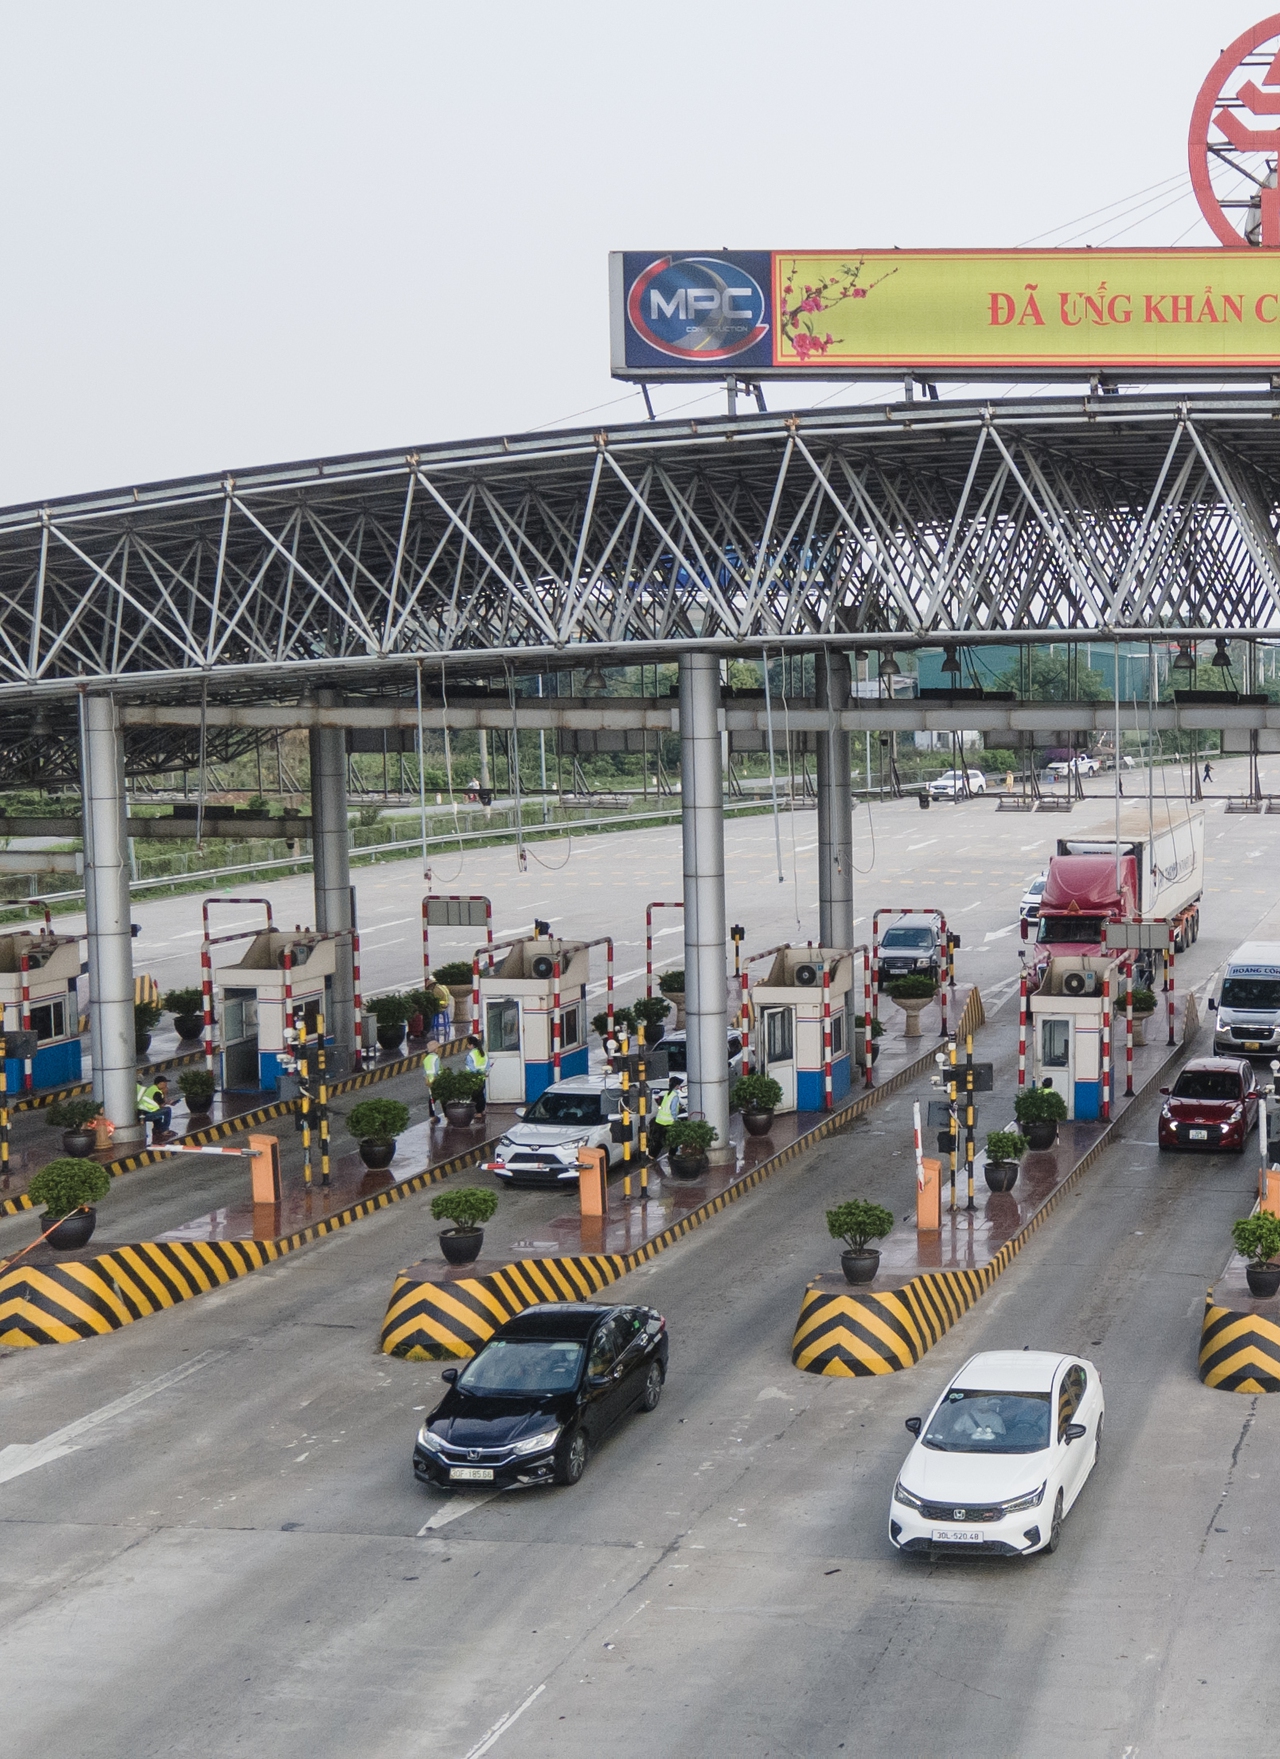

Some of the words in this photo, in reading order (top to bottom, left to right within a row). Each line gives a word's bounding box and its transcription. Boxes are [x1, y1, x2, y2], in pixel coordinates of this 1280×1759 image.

[650, 287, 753, 320] MPC
[988, 283, 1045, 326] ĐÃ
[1143, 286, 1244, 324] KHẨN
